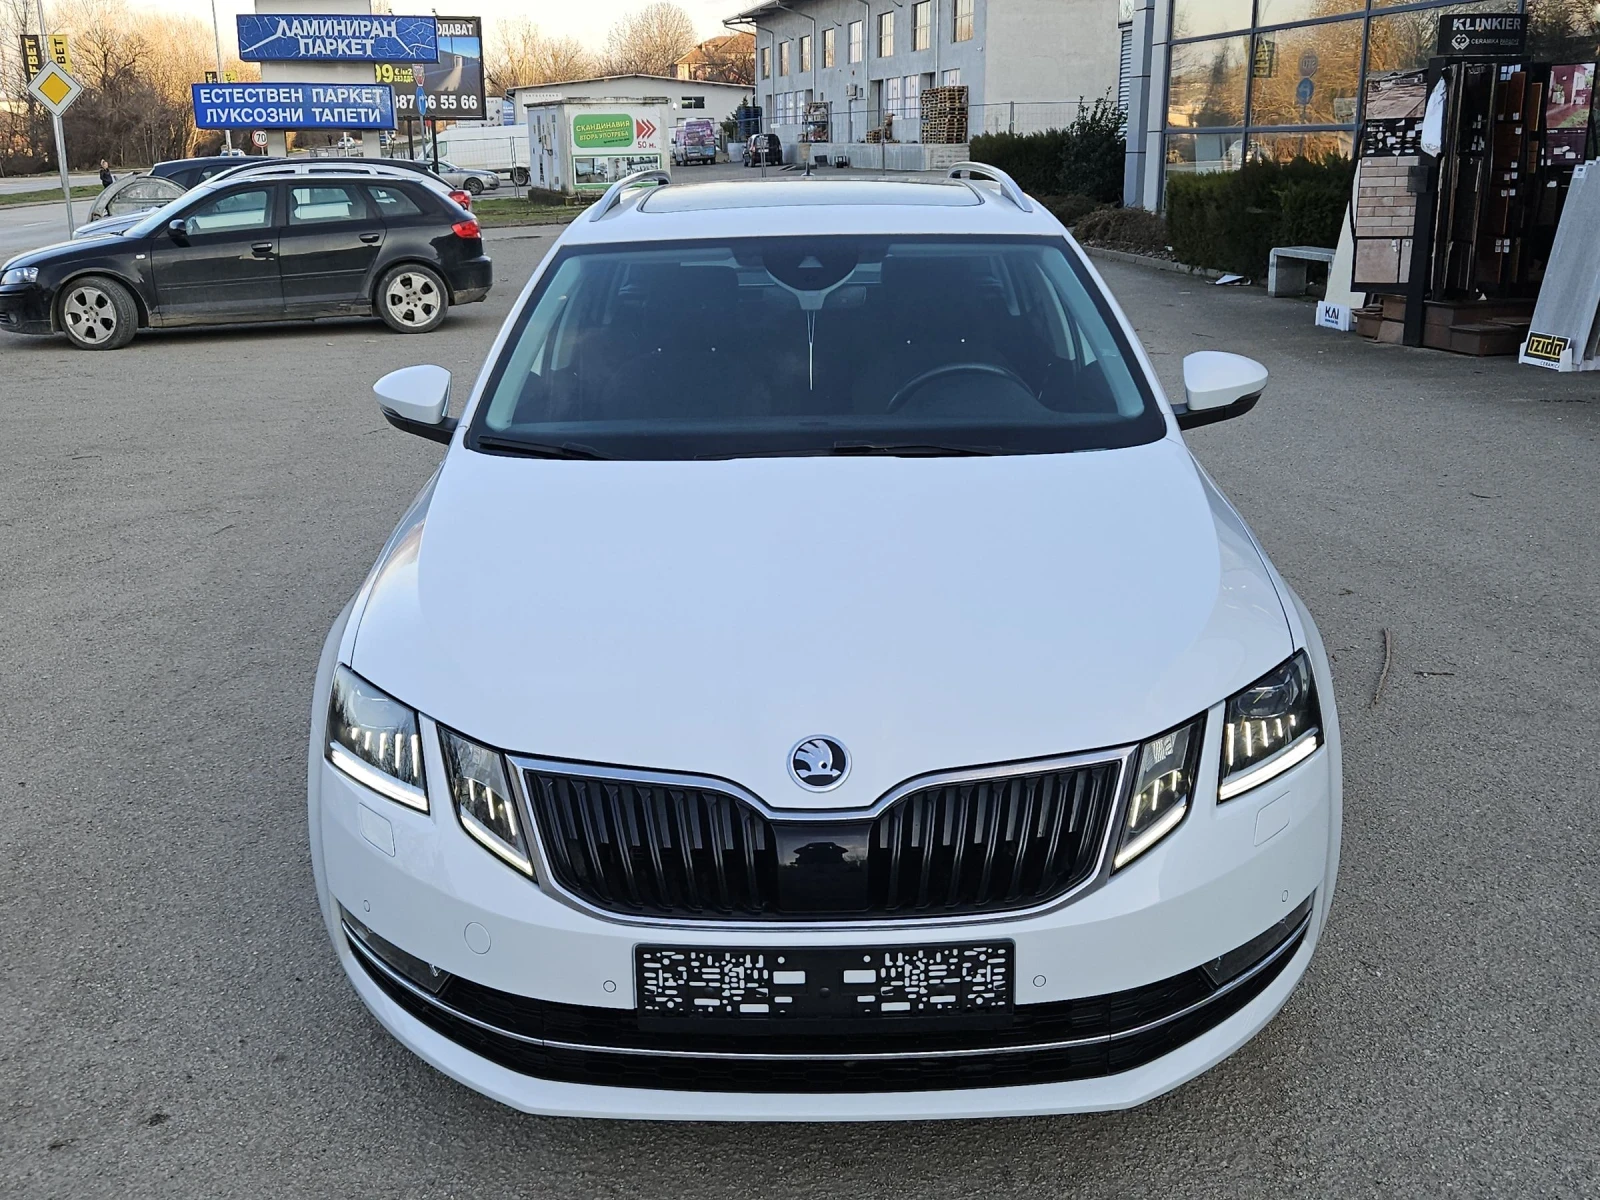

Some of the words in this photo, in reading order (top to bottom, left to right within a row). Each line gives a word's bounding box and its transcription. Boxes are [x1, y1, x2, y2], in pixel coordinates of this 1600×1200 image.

[277, 20, 397, 38] ЛАМИНИРАН
[1452, 18, 1521, 31] KLINKIER
[300, 38, 376, 55] ПАРКЕТ
[200, 88, 304, 104] ЕСТЕСТВЕН
[312, 88, 383, 103] ПАРКЕТ
[440, 95, 457, 109] 55
[460, 95, 478, 109] 66
[206, 107, 304, 123] ЛУКСОЗНИ
[312, 108, 381, 123] ТАПЕТИ
[576, 120, 630, 132] СКАНДИНАВИЯ
[256, 133, 267, 142] 70
[579, 133, 598, 141] ВТОРА
[599, 131, 629, 139] УПОТРЕБА
[1325, 306, 1339, 319] KAI
